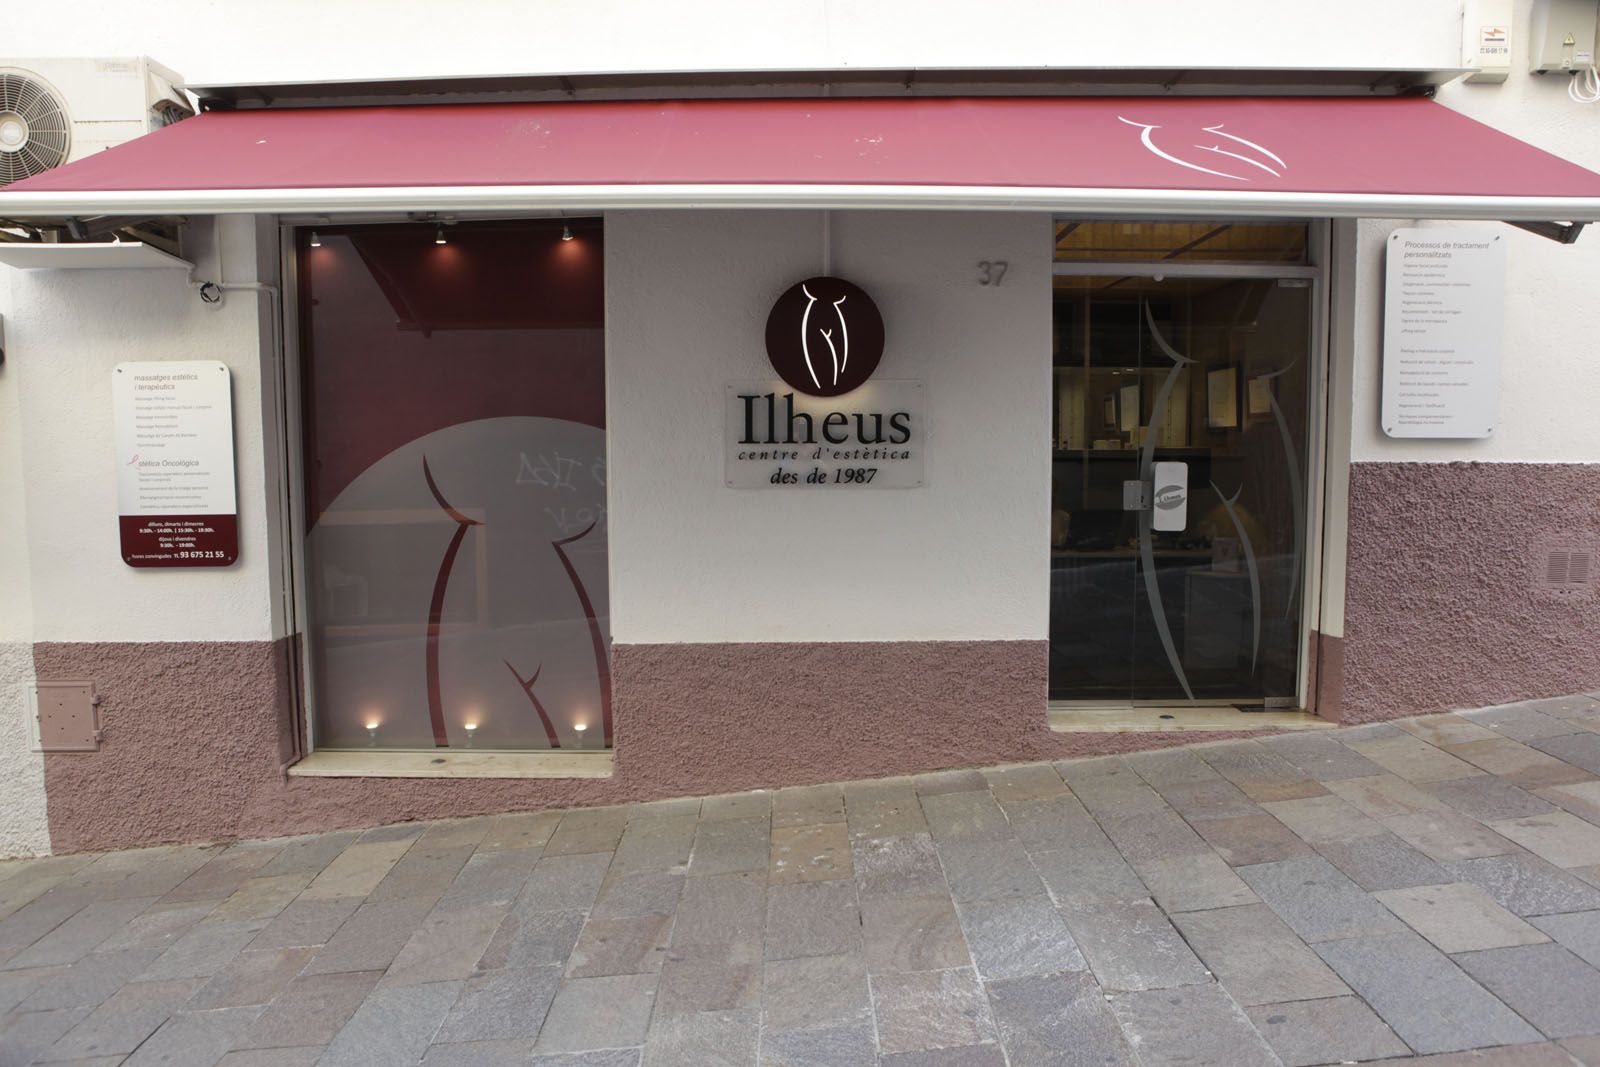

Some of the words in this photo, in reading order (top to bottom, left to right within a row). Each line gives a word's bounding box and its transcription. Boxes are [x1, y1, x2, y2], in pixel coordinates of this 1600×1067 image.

[1404, 240, 1440, 249] Processos
[1442, 241, 1451, 249] de
[1403, 251, 1453, 259] personalitzats
[977, 260, 1009, 287] 37
[737, 392, 911, 445] Ilheus
[738, 448, 799, 460] centre
[812, 447, 910, 460] d'estètica
[770, 467, 798, 485] des
[806, 467, 827, 485] de
[834, 468, 878, 485] 1987
[215, 550, 225, 558] 55
